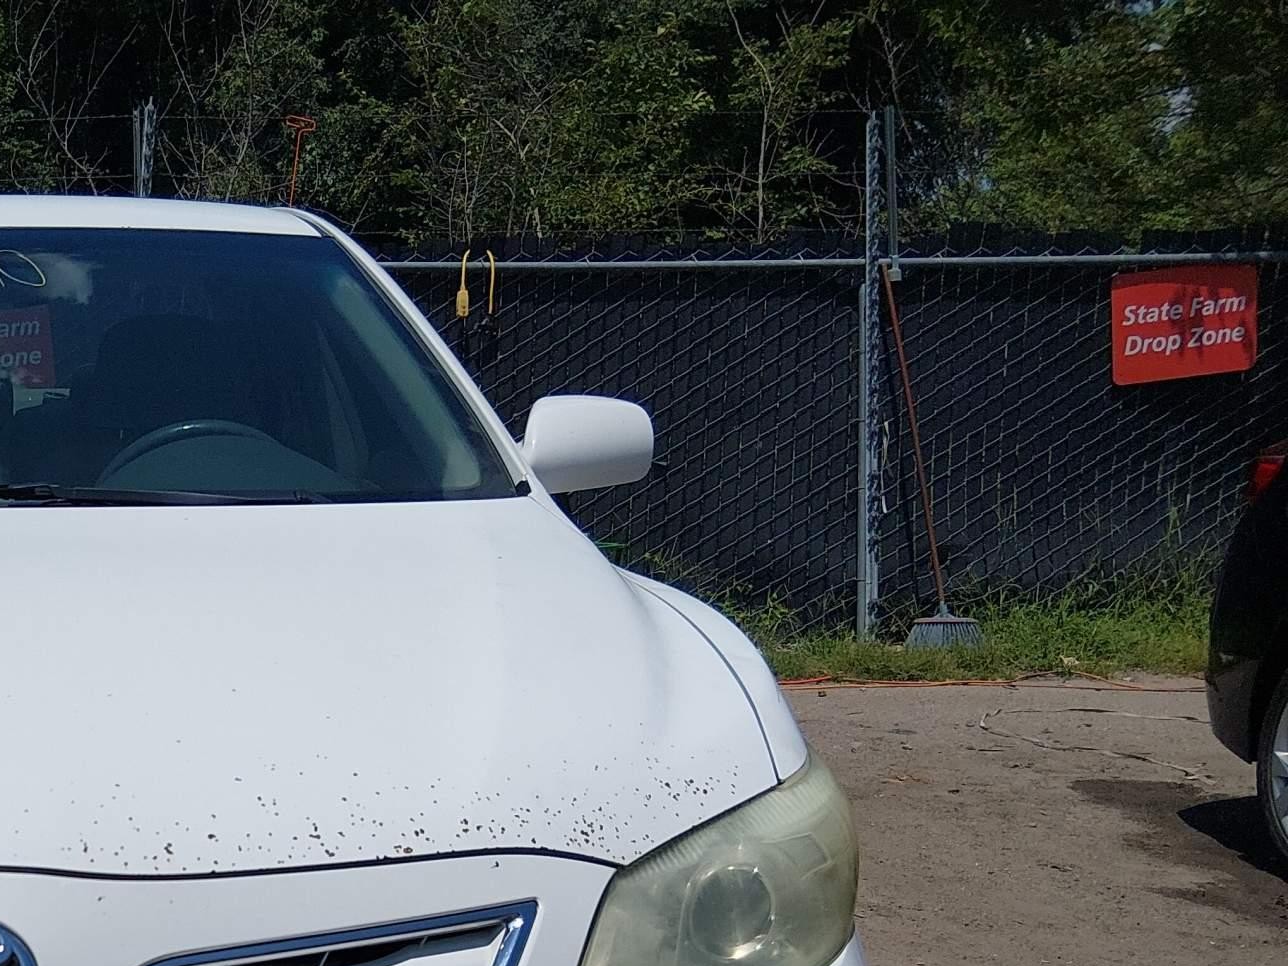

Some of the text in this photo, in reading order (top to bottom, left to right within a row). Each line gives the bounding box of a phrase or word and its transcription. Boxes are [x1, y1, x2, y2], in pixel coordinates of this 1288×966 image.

[1122, 295, 1246, 326] State Farm
[1124, 325, 1245, 356] Drop Zone
